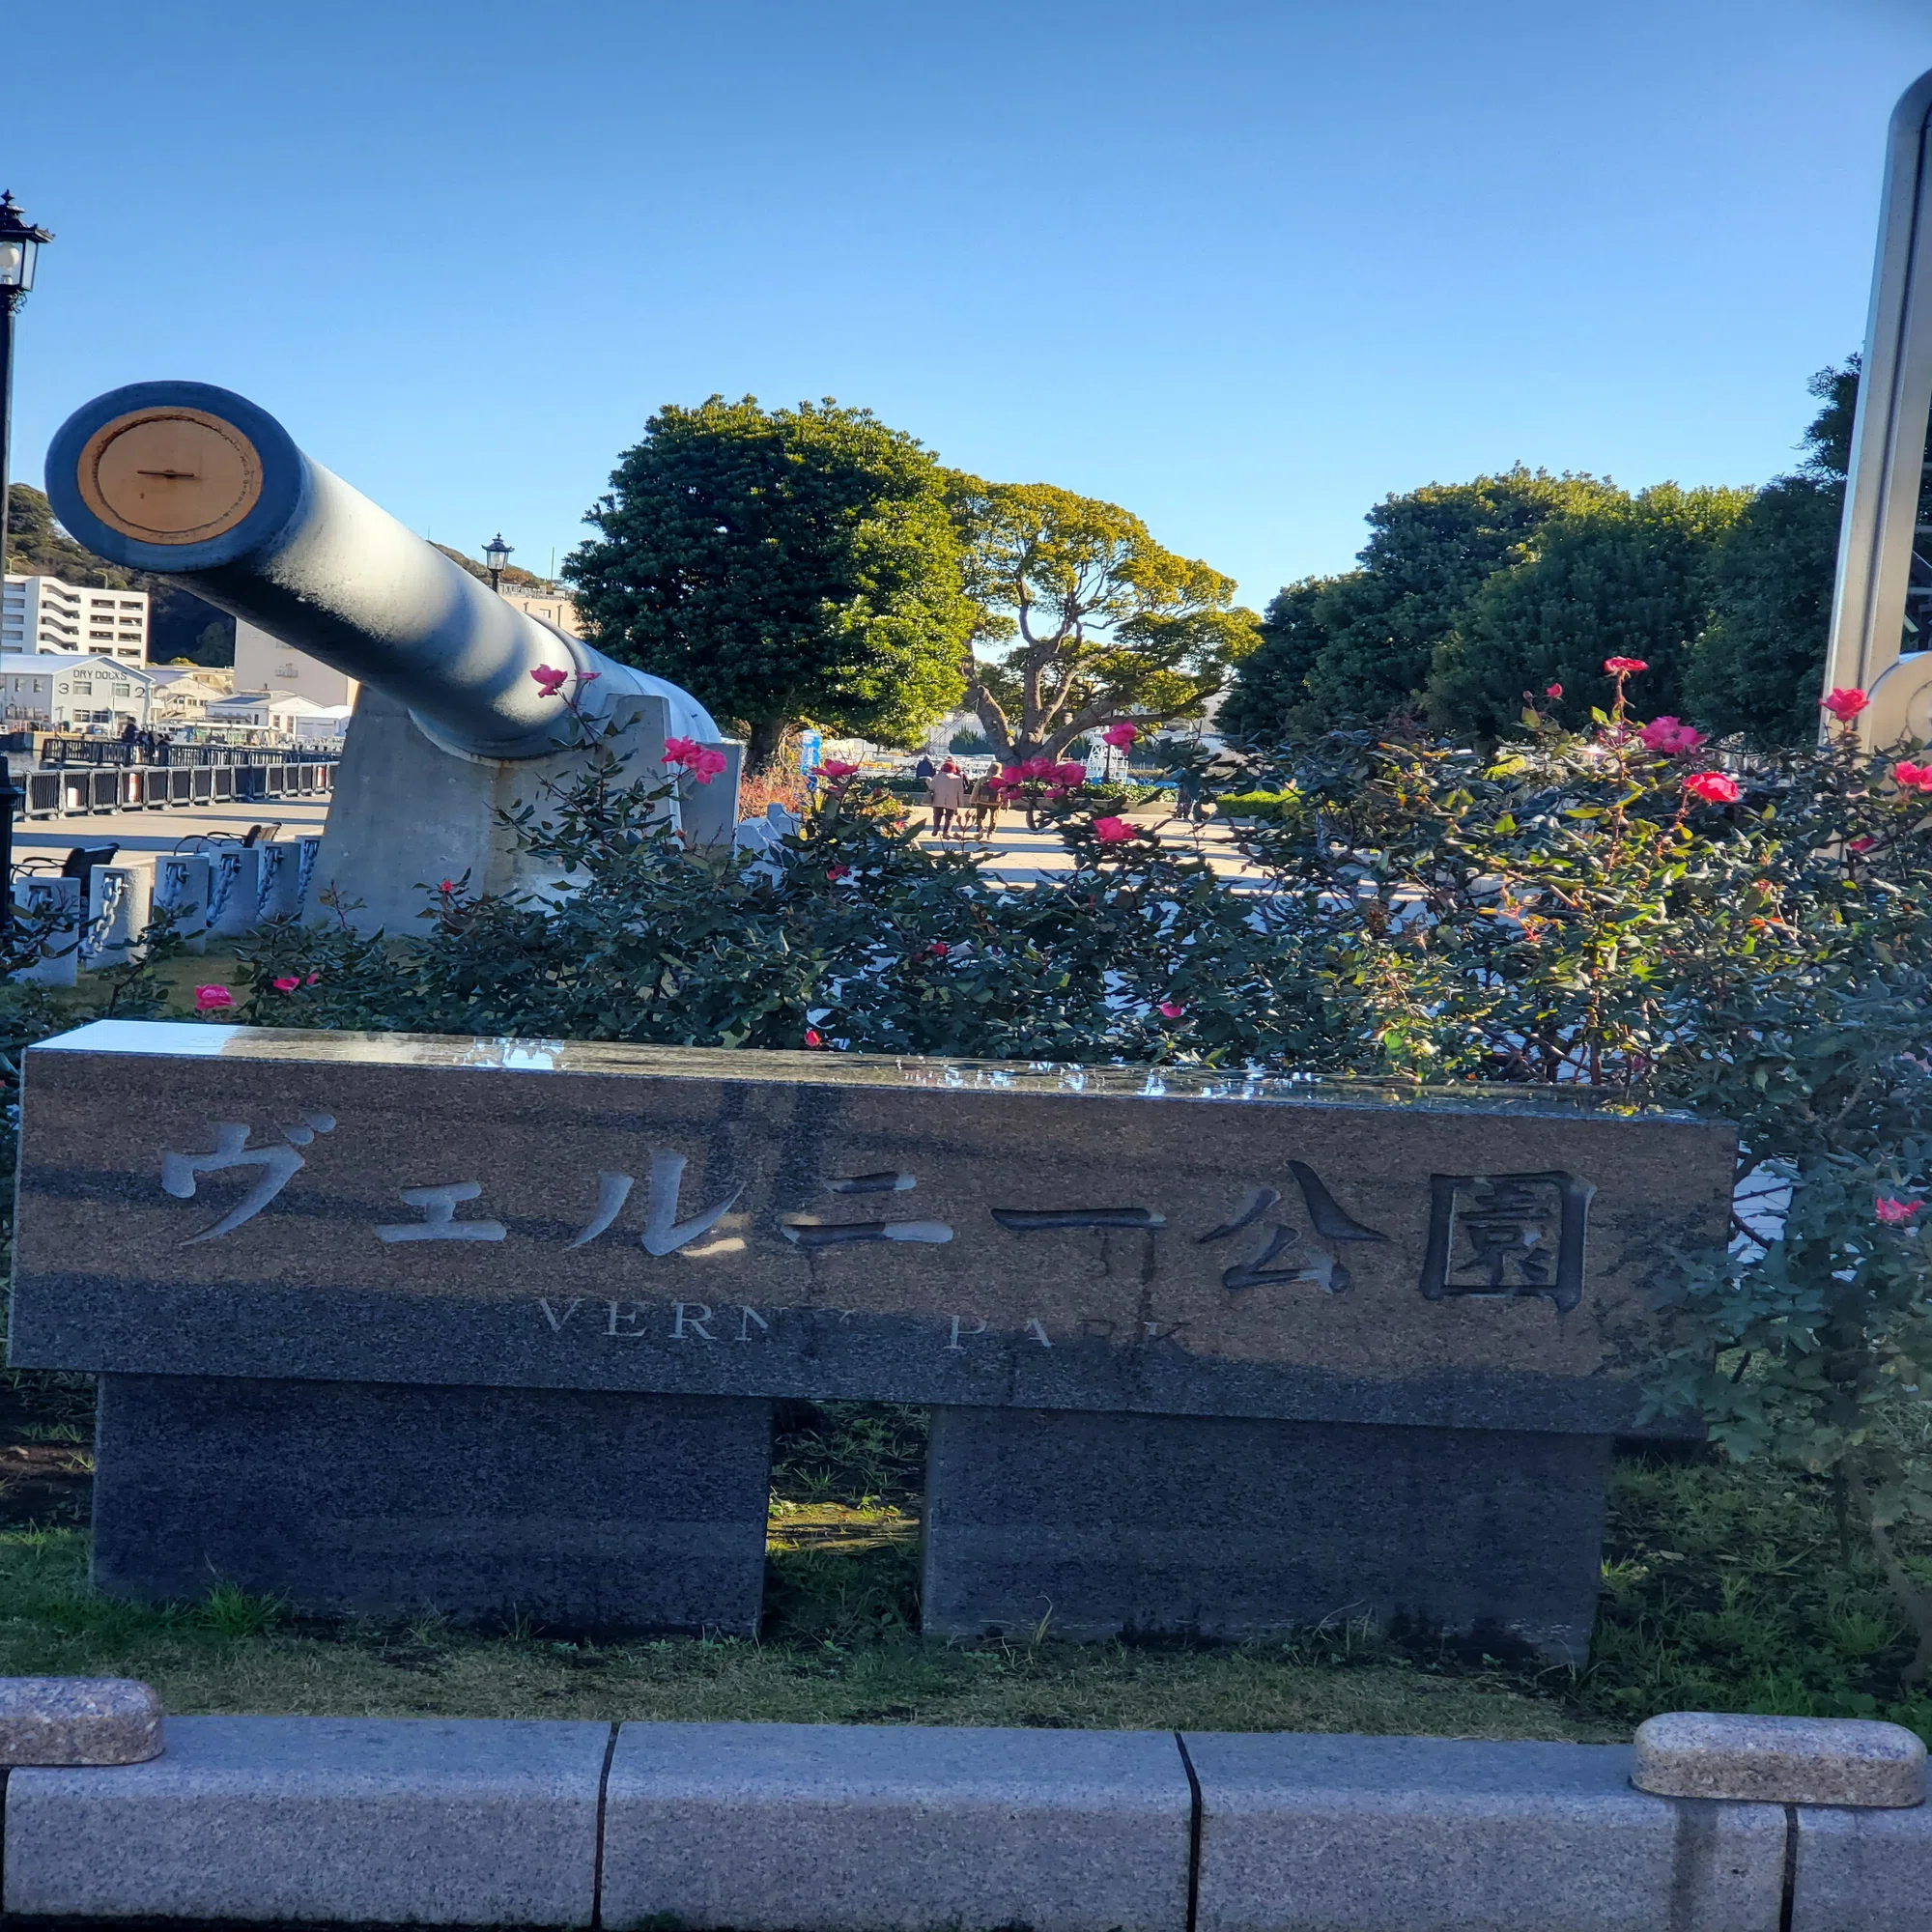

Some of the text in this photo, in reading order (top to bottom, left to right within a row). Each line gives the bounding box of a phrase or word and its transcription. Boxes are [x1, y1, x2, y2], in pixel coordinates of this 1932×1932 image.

[73, 669, 128, 680] DRY DOCKS
[58, 683, 70, 695] 3
[134, 686, 146, 697] 2
[160, 1112, 1598, 1314] ヴェルニー公園
[537, 1297, 856, 1343] VERN
